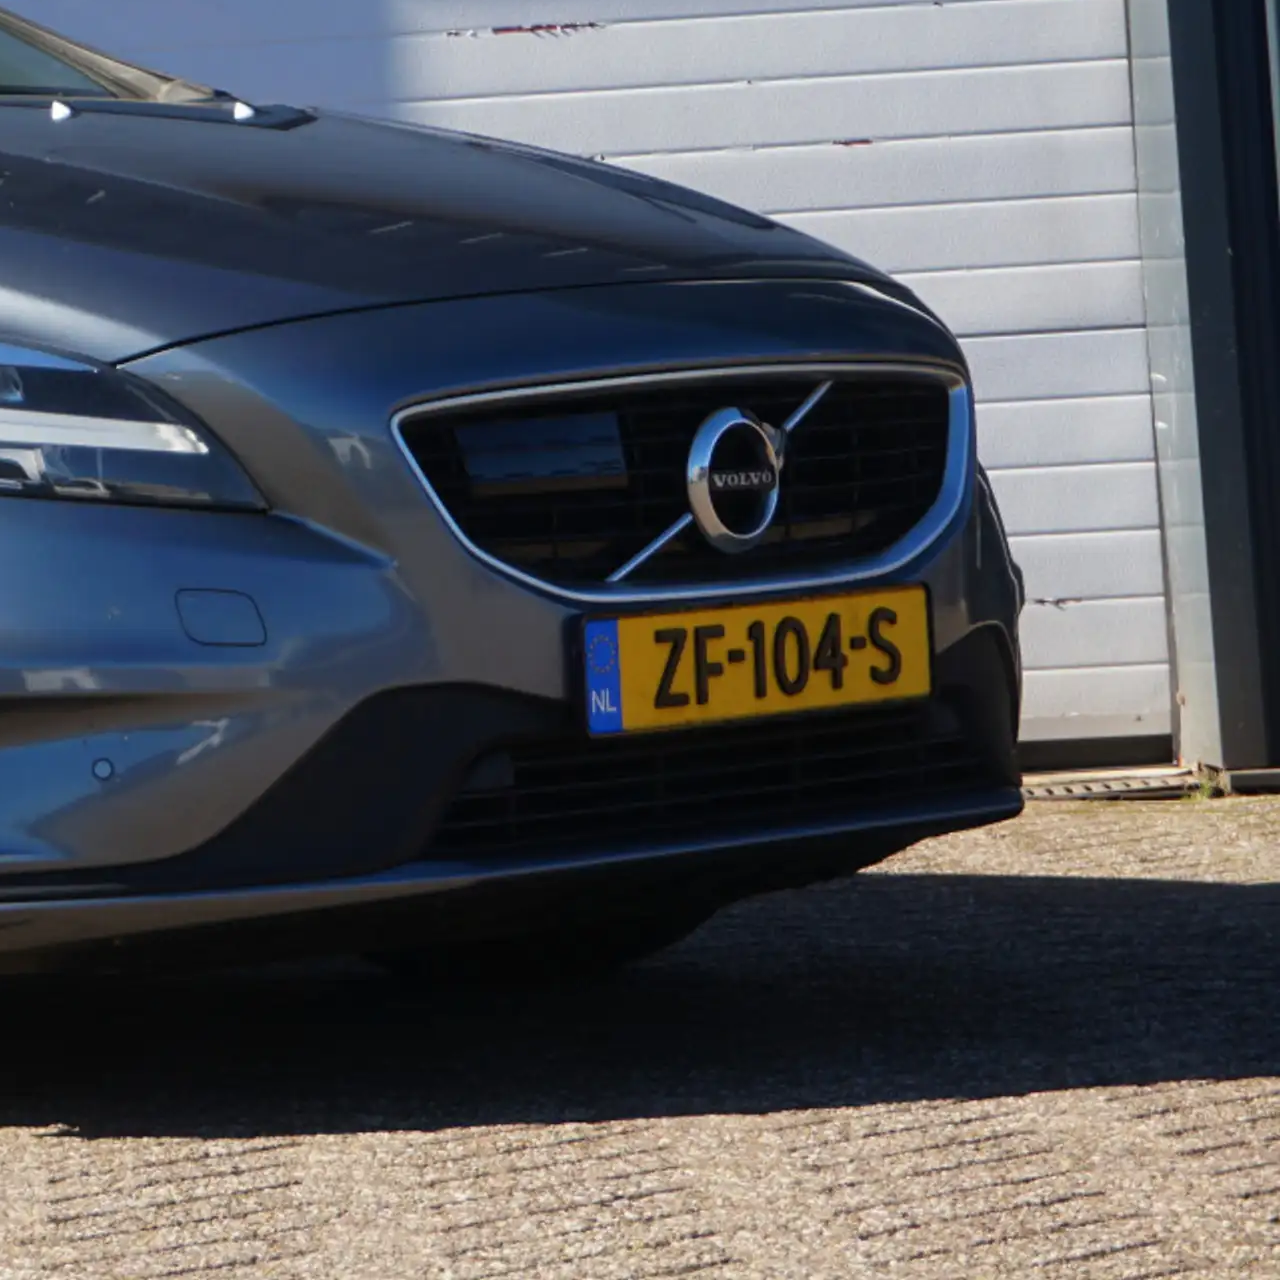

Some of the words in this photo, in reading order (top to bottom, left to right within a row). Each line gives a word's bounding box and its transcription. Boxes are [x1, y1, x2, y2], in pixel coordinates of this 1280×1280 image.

[712, 471, 772, 488] VOLVO
[591, 689, 617, 715] NL
[654, 606, 903, 710] ZF-104-S
